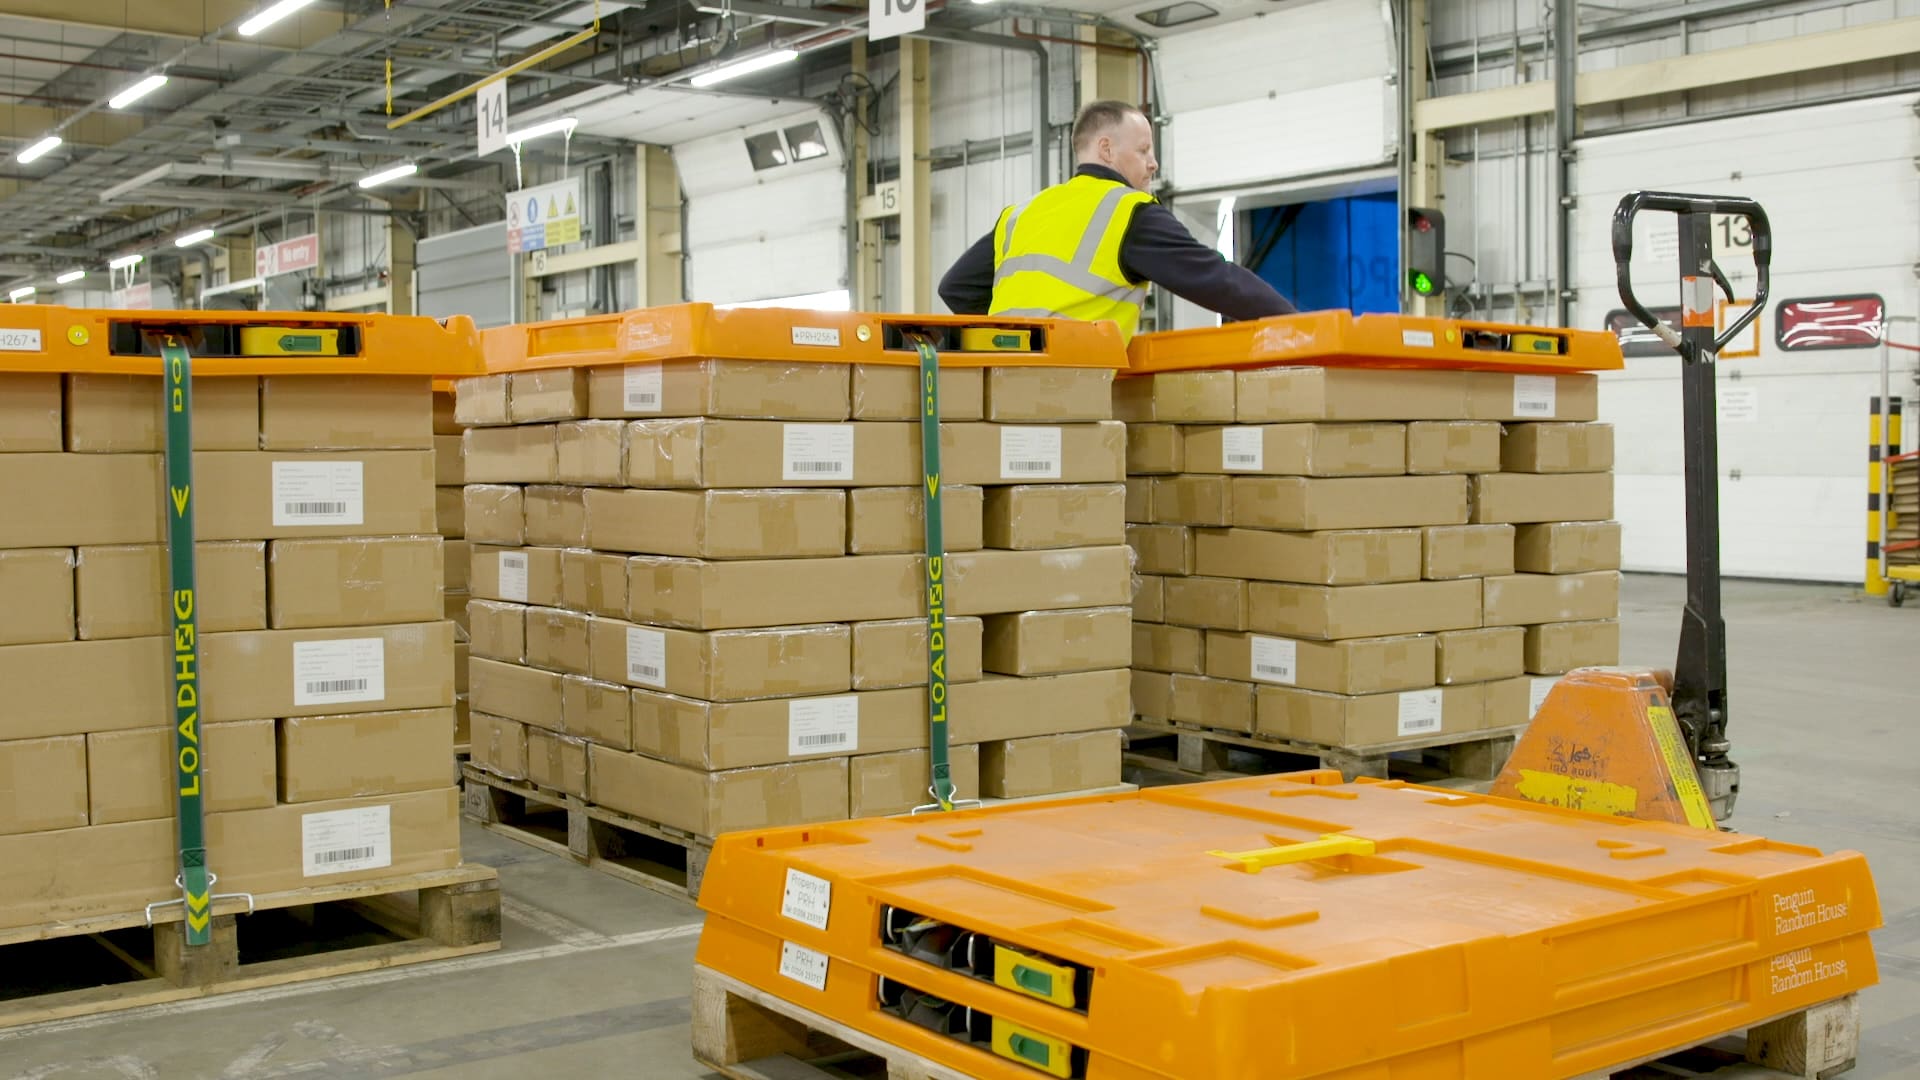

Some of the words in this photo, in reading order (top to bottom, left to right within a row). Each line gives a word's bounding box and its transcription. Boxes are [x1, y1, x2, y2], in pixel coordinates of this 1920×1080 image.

[481, 92, 504, 139] 14
[880, 187, 896, 210] 15
[1717, 215, 1752, 248] 13
[791, 873, 817, 893] Property
[797, 891, 816, 909] PRH
[1773, 888, 1815, 914] Penguin
[1775, 910, 1816, 936] Random
[1817, 902, 1848, 924] House
[795, 949, 814, 969] PRH
[1770, 947, 1812, 973] Penguin
[1771, 968, 1813, 995] Random
[1814, 960, 1847, 982] House
